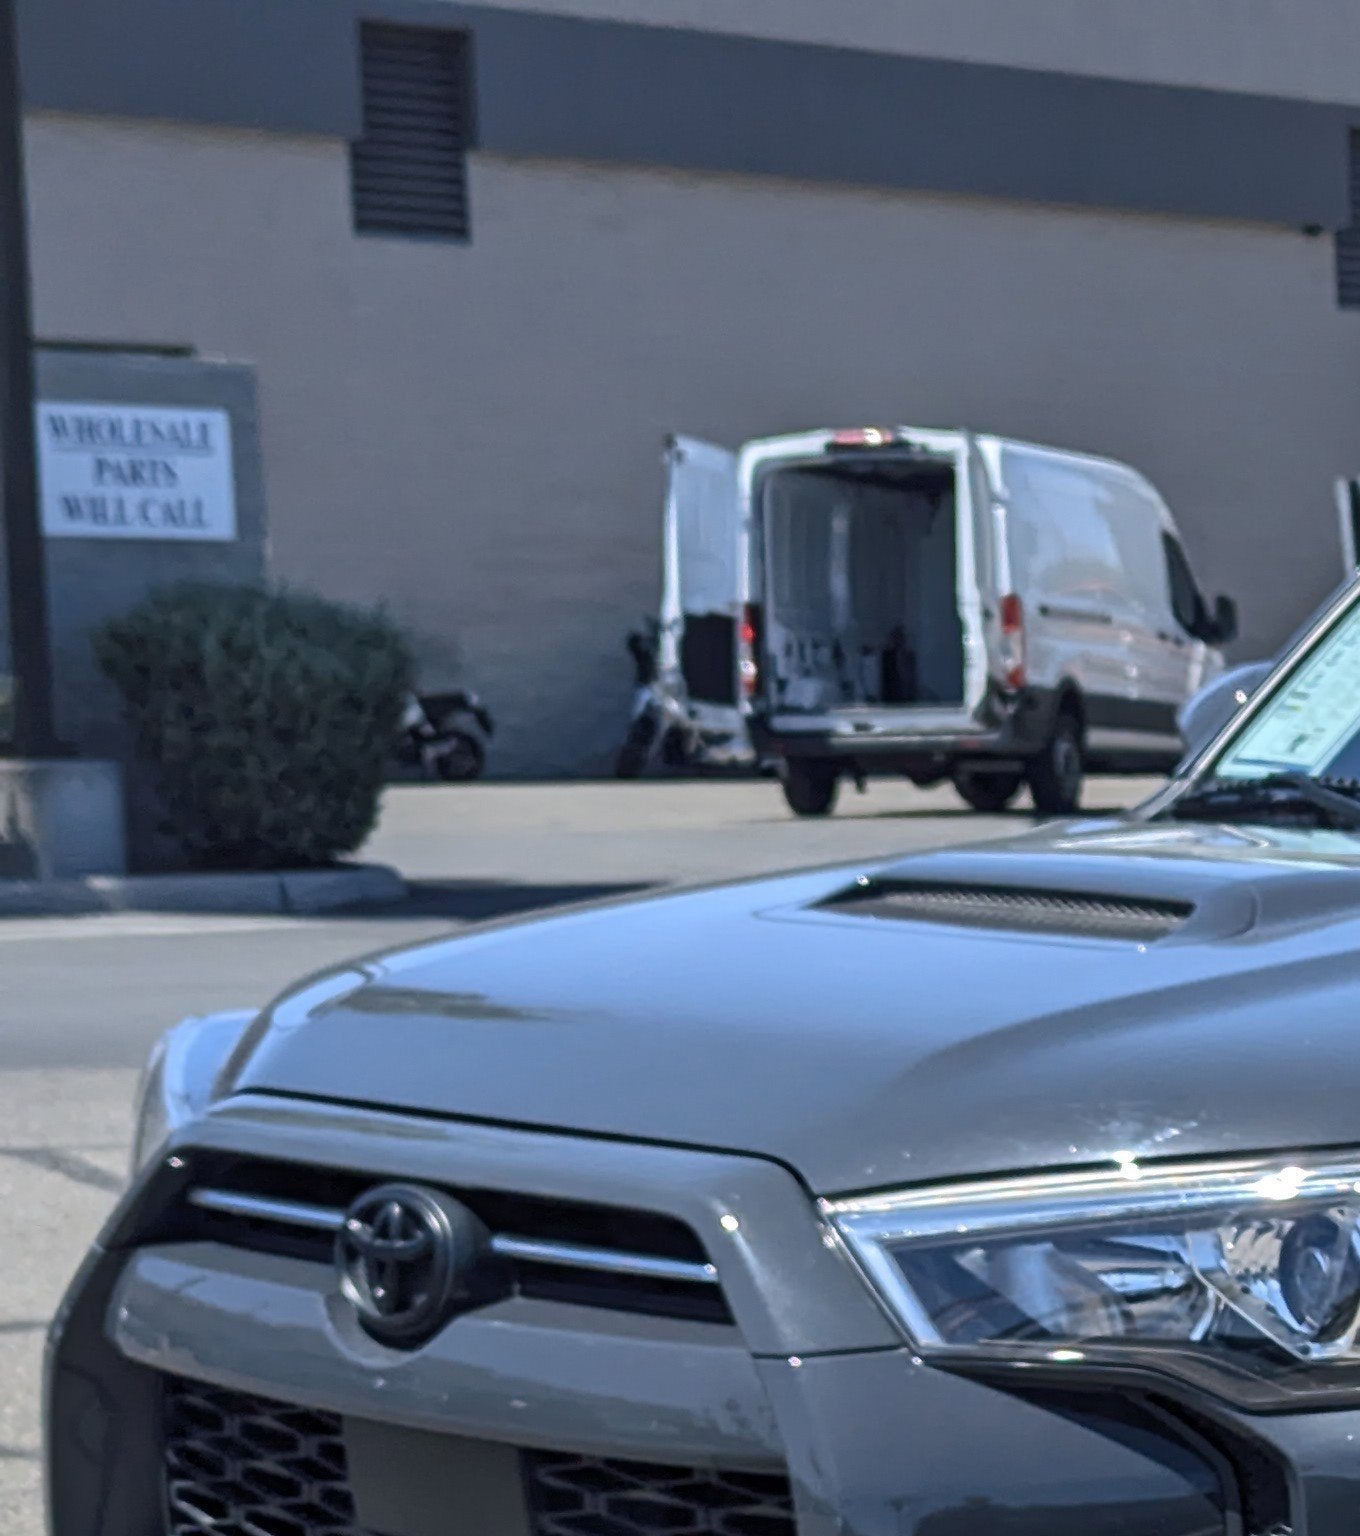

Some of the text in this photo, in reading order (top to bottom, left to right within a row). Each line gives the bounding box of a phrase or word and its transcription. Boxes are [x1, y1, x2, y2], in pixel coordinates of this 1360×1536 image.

[49, 413, 212, 450] WHOLESALE
[94, 456, 179, 489] PARTS
[60, 495, 210, 530] WILL CALL
